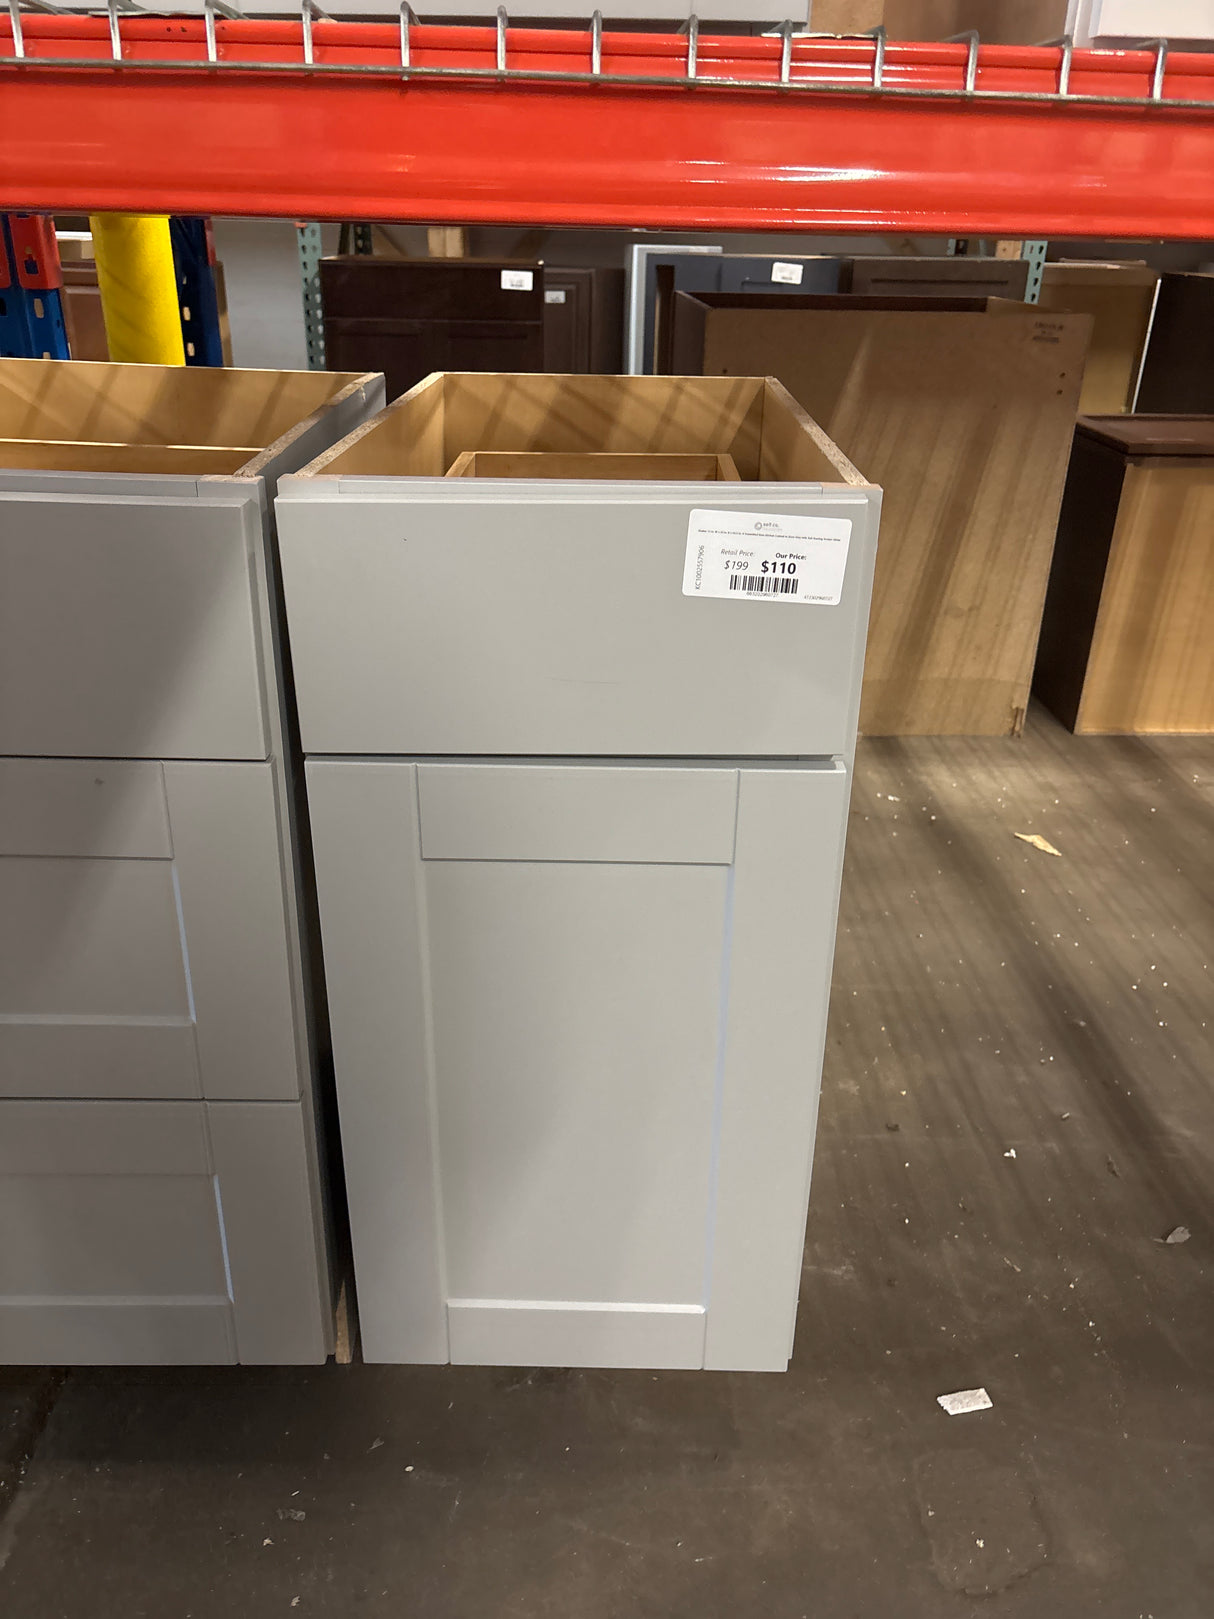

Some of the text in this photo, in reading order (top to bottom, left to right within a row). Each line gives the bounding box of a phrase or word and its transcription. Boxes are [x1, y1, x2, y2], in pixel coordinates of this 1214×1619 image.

[720, 548, 738, 557] Retail
[775, 552, 807, 561] Our Price:
[724, 560, 797, 575] $199 $110
